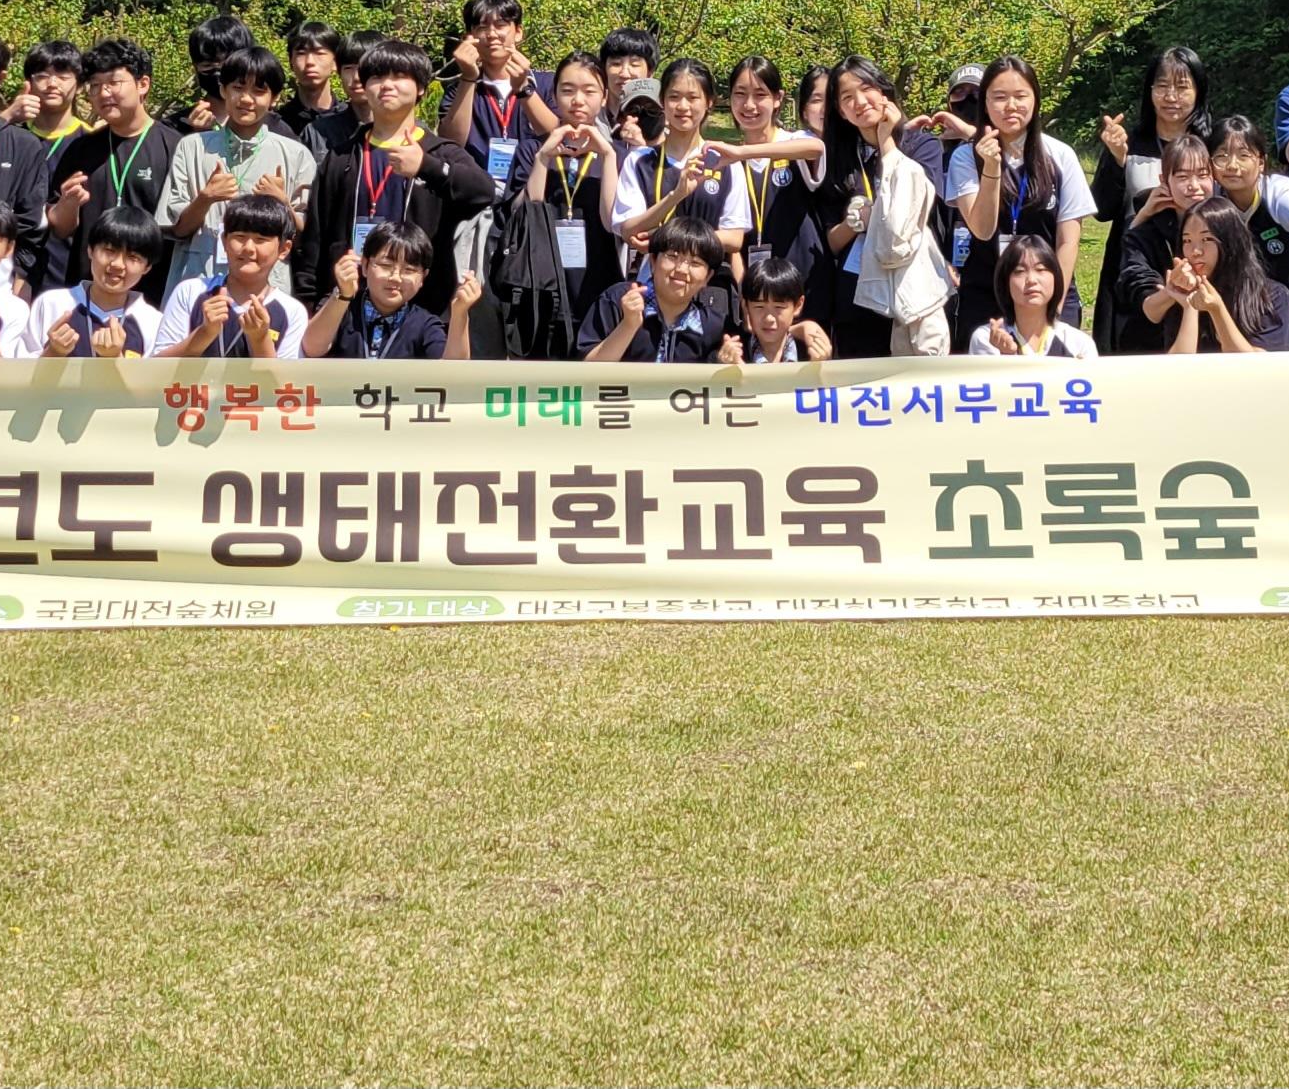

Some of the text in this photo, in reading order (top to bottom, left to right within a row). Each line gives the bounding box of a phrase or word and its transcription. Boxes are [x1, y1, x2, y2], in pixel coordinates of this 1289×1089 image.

[164, 377, 1103, 432] 행복한 학교 미래를 여는 대전서부교육
[201, 464, 886, 567] 생태전환교육
[928, 459, 1260, 561] 초록숲
[36, 599, 276, 621] 국립대전숲체원
[352, 600, 416, 617] 참가
